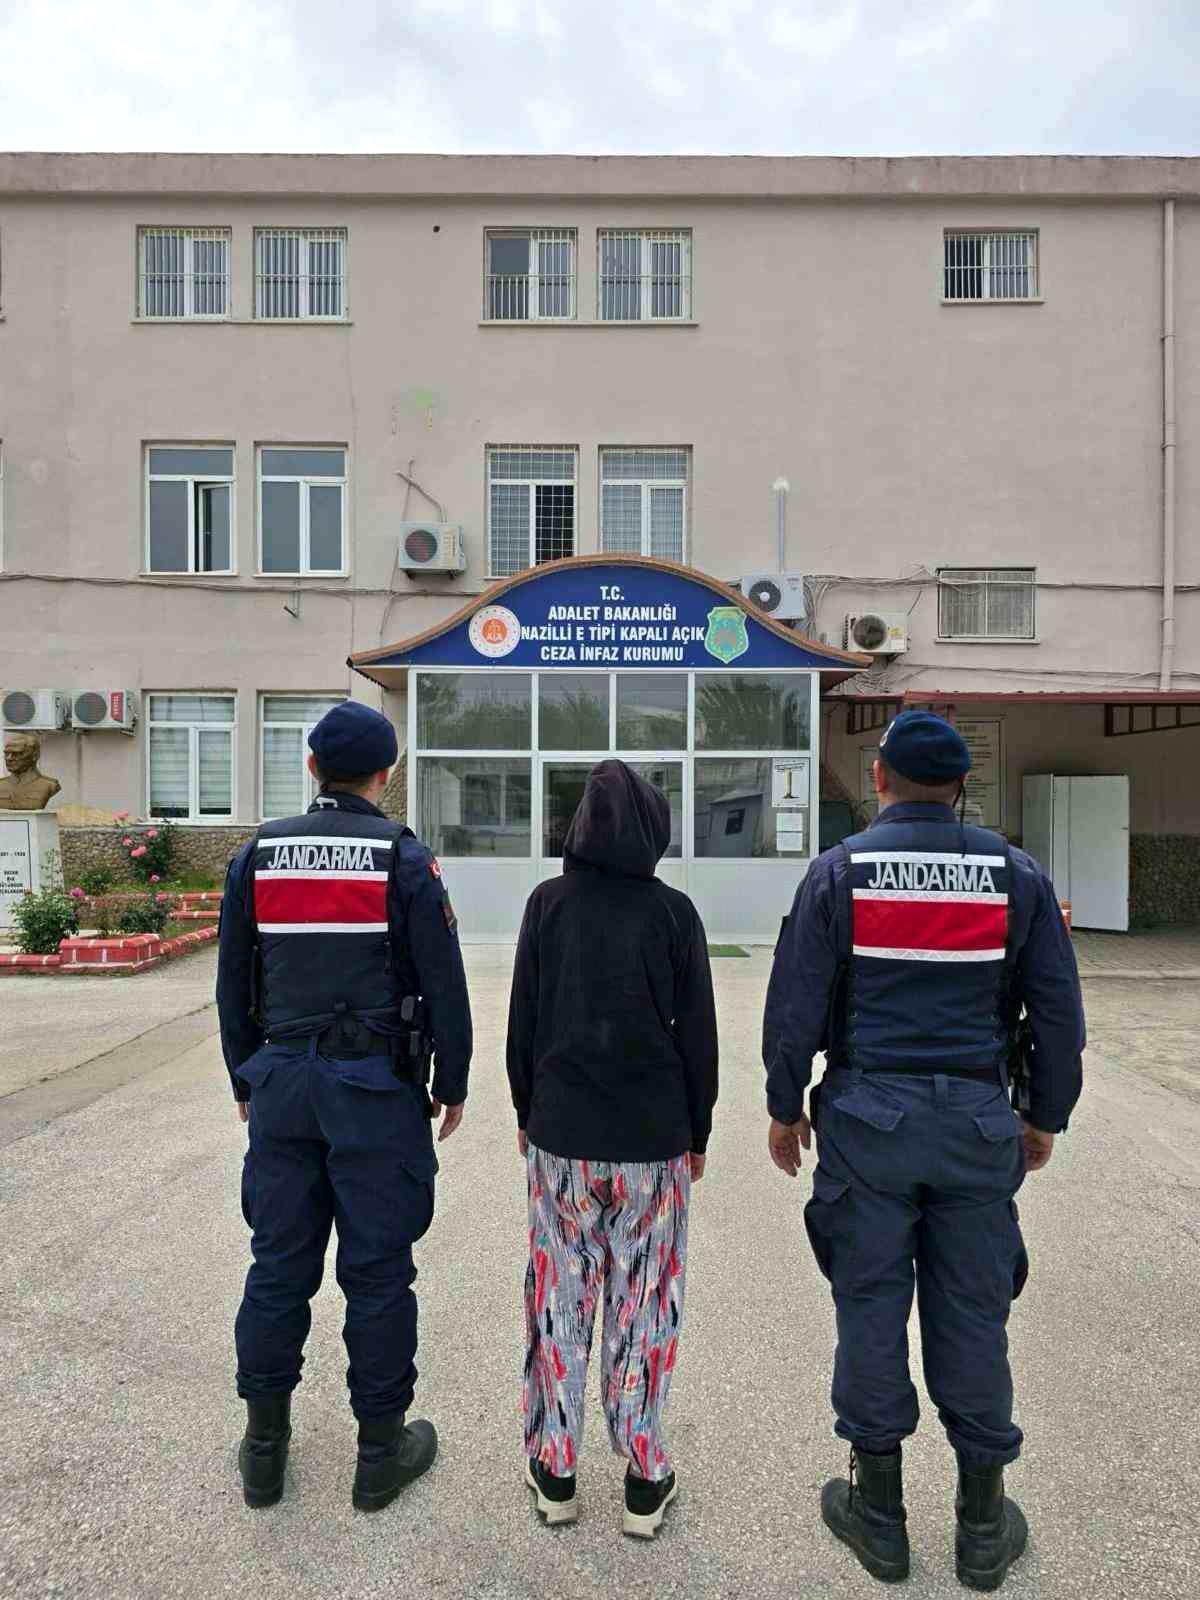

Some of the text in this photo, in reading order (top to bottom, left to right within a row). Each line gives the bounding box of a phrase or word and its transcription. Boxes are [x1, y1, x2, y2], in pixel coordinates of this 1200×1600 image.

[600, 585, 625, 601] T.C.
[547, 603, 677, 621] ADALET BAKANLIĞI
[520, 624, 705, 644] NAZİLLİ E TİPİ KAPALI AÇIK
[540, 643, 684, 661] CEZA İNFAZ KURUMU
[267, 844, 376, 871] JANDARMA
[867, 861, 997, 893] JANDARMA
